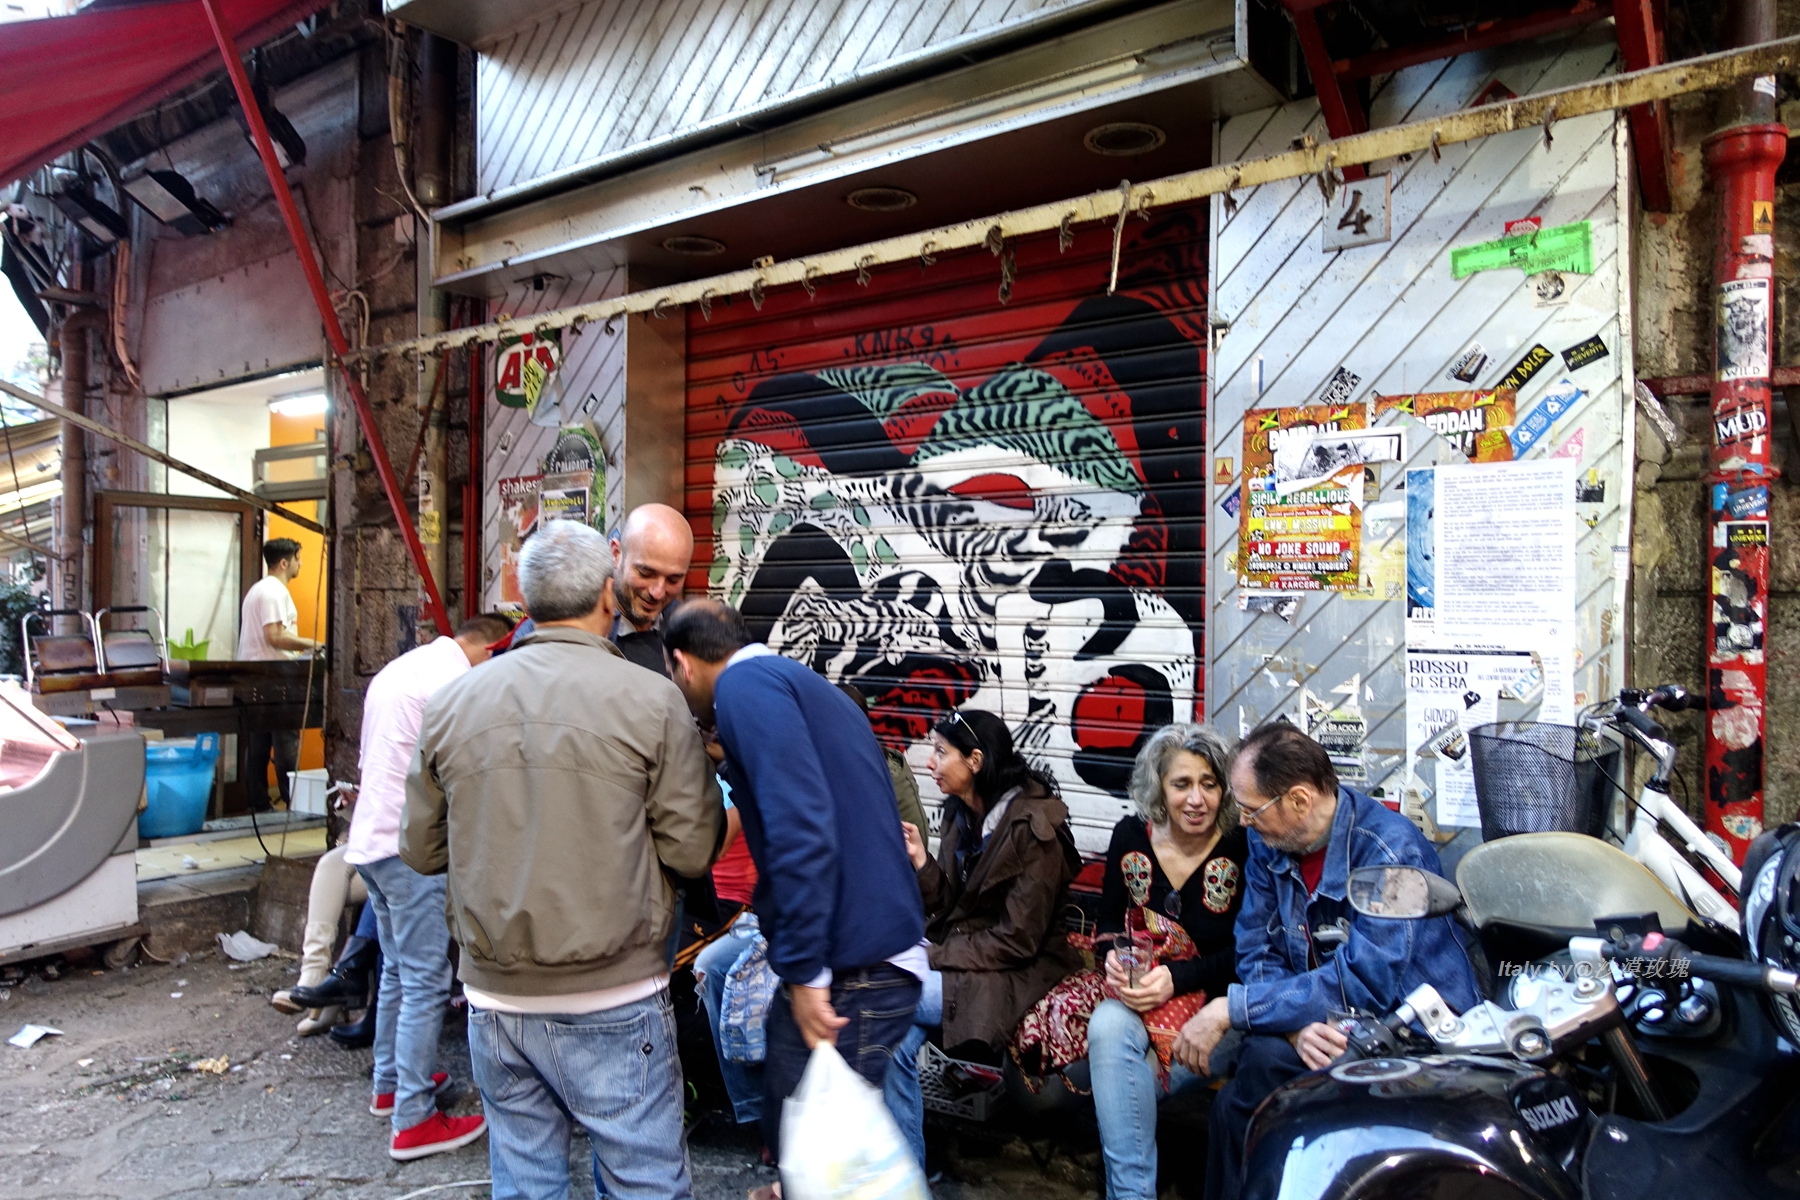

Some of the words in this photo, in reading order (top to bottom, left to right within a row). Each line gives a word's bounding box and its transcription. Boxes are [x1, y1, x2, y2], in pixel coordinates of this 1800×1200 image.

[1337, 189, 1373, 235] 4
[1725, 366, 1761, 377] WILD
[1717, 411, 1766, 441] MUD
[1264, 519, 1288, 530] ENNA
[1292, 517, 1334, 529] MASSIVE
[1258, 542, 1272, 555] NO
[1275, 542, 1302, 555] JOKE
[1306, 541, 1341, 554] SOUND
[1240, 574, 1249, 587] 4
[1281, 580, 1321, 590] KARCERE
[1409, 659, 1468, 674] ROSSO
[1411, 676, 1424, 688] DI
[1429, 676, 1467, 689] SERA
[1521, 1096, 1579, 1132] SUZUKI
